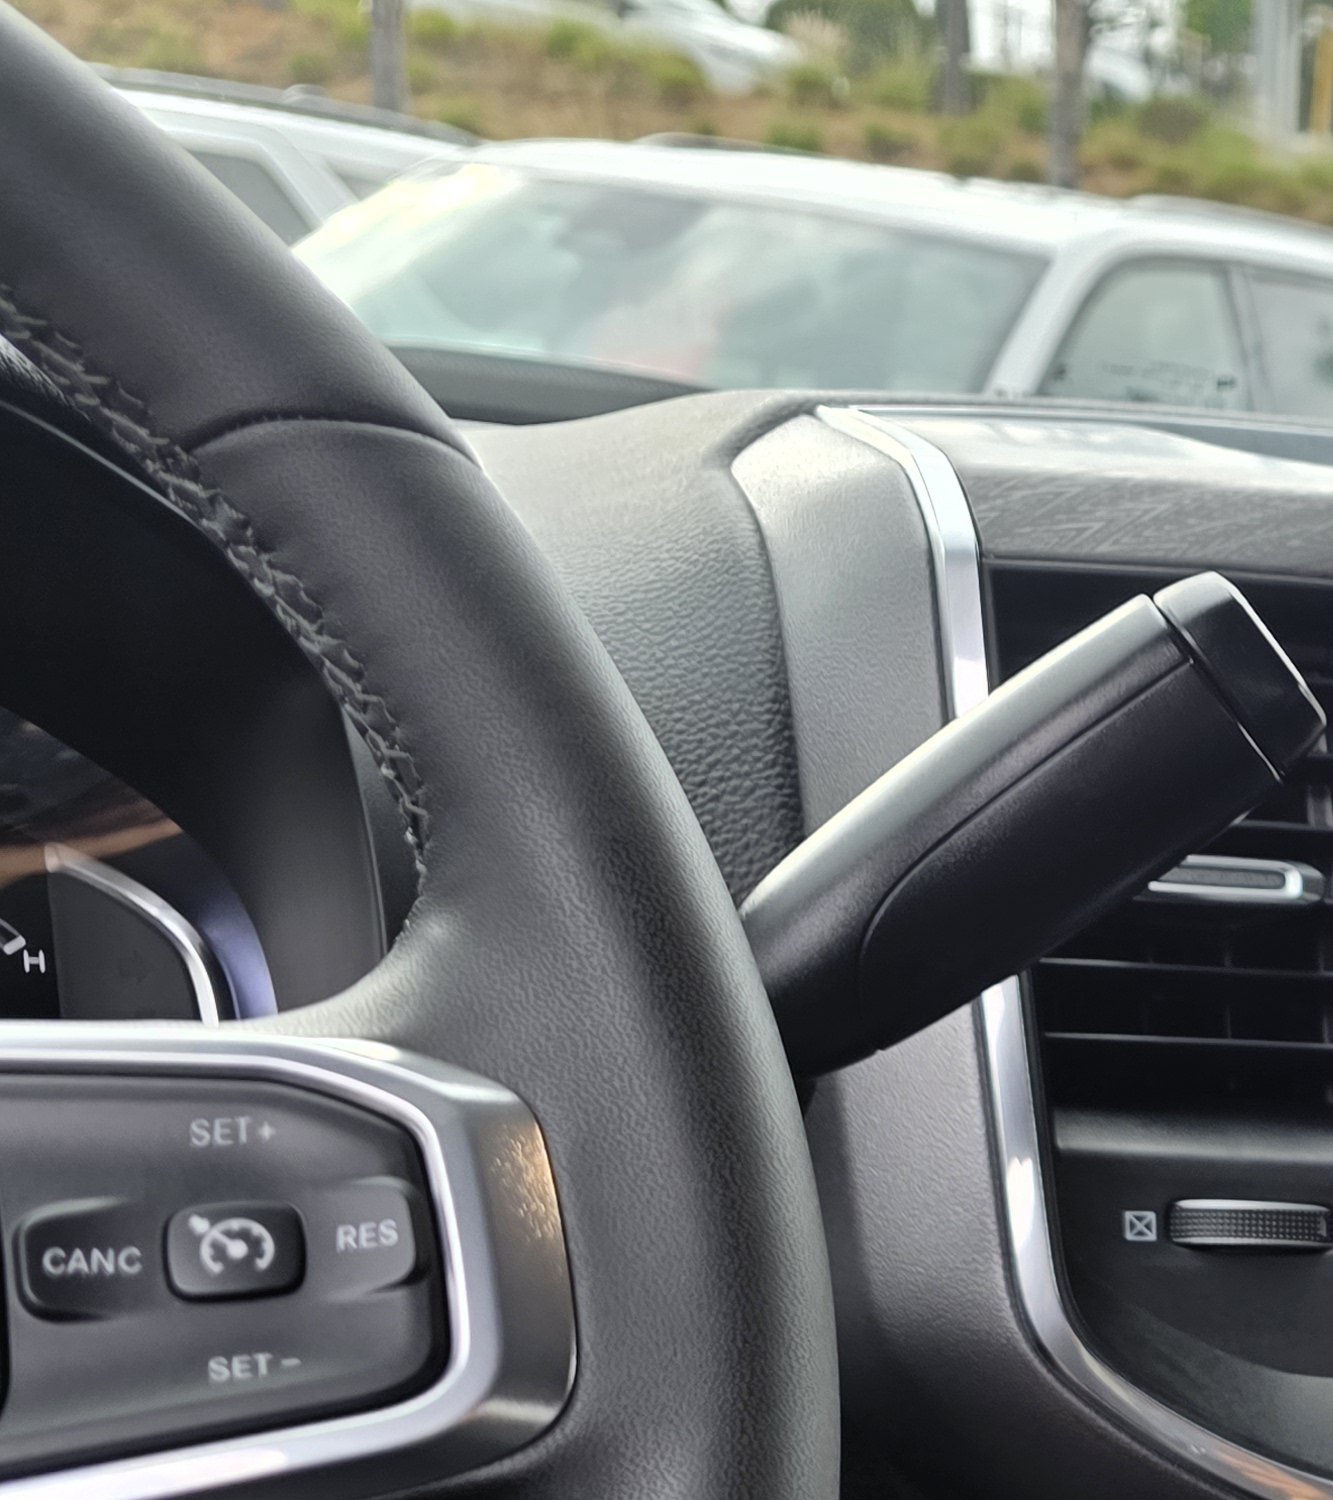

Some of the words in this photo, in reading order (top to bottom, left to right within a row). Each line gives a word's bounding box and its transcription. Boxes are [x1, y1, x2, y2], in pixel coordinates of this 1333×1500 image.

[22, 948, 47, 974] H
[335, 1218, 399, 1254] RES
[41, 1245, 143, 1276] CANC
